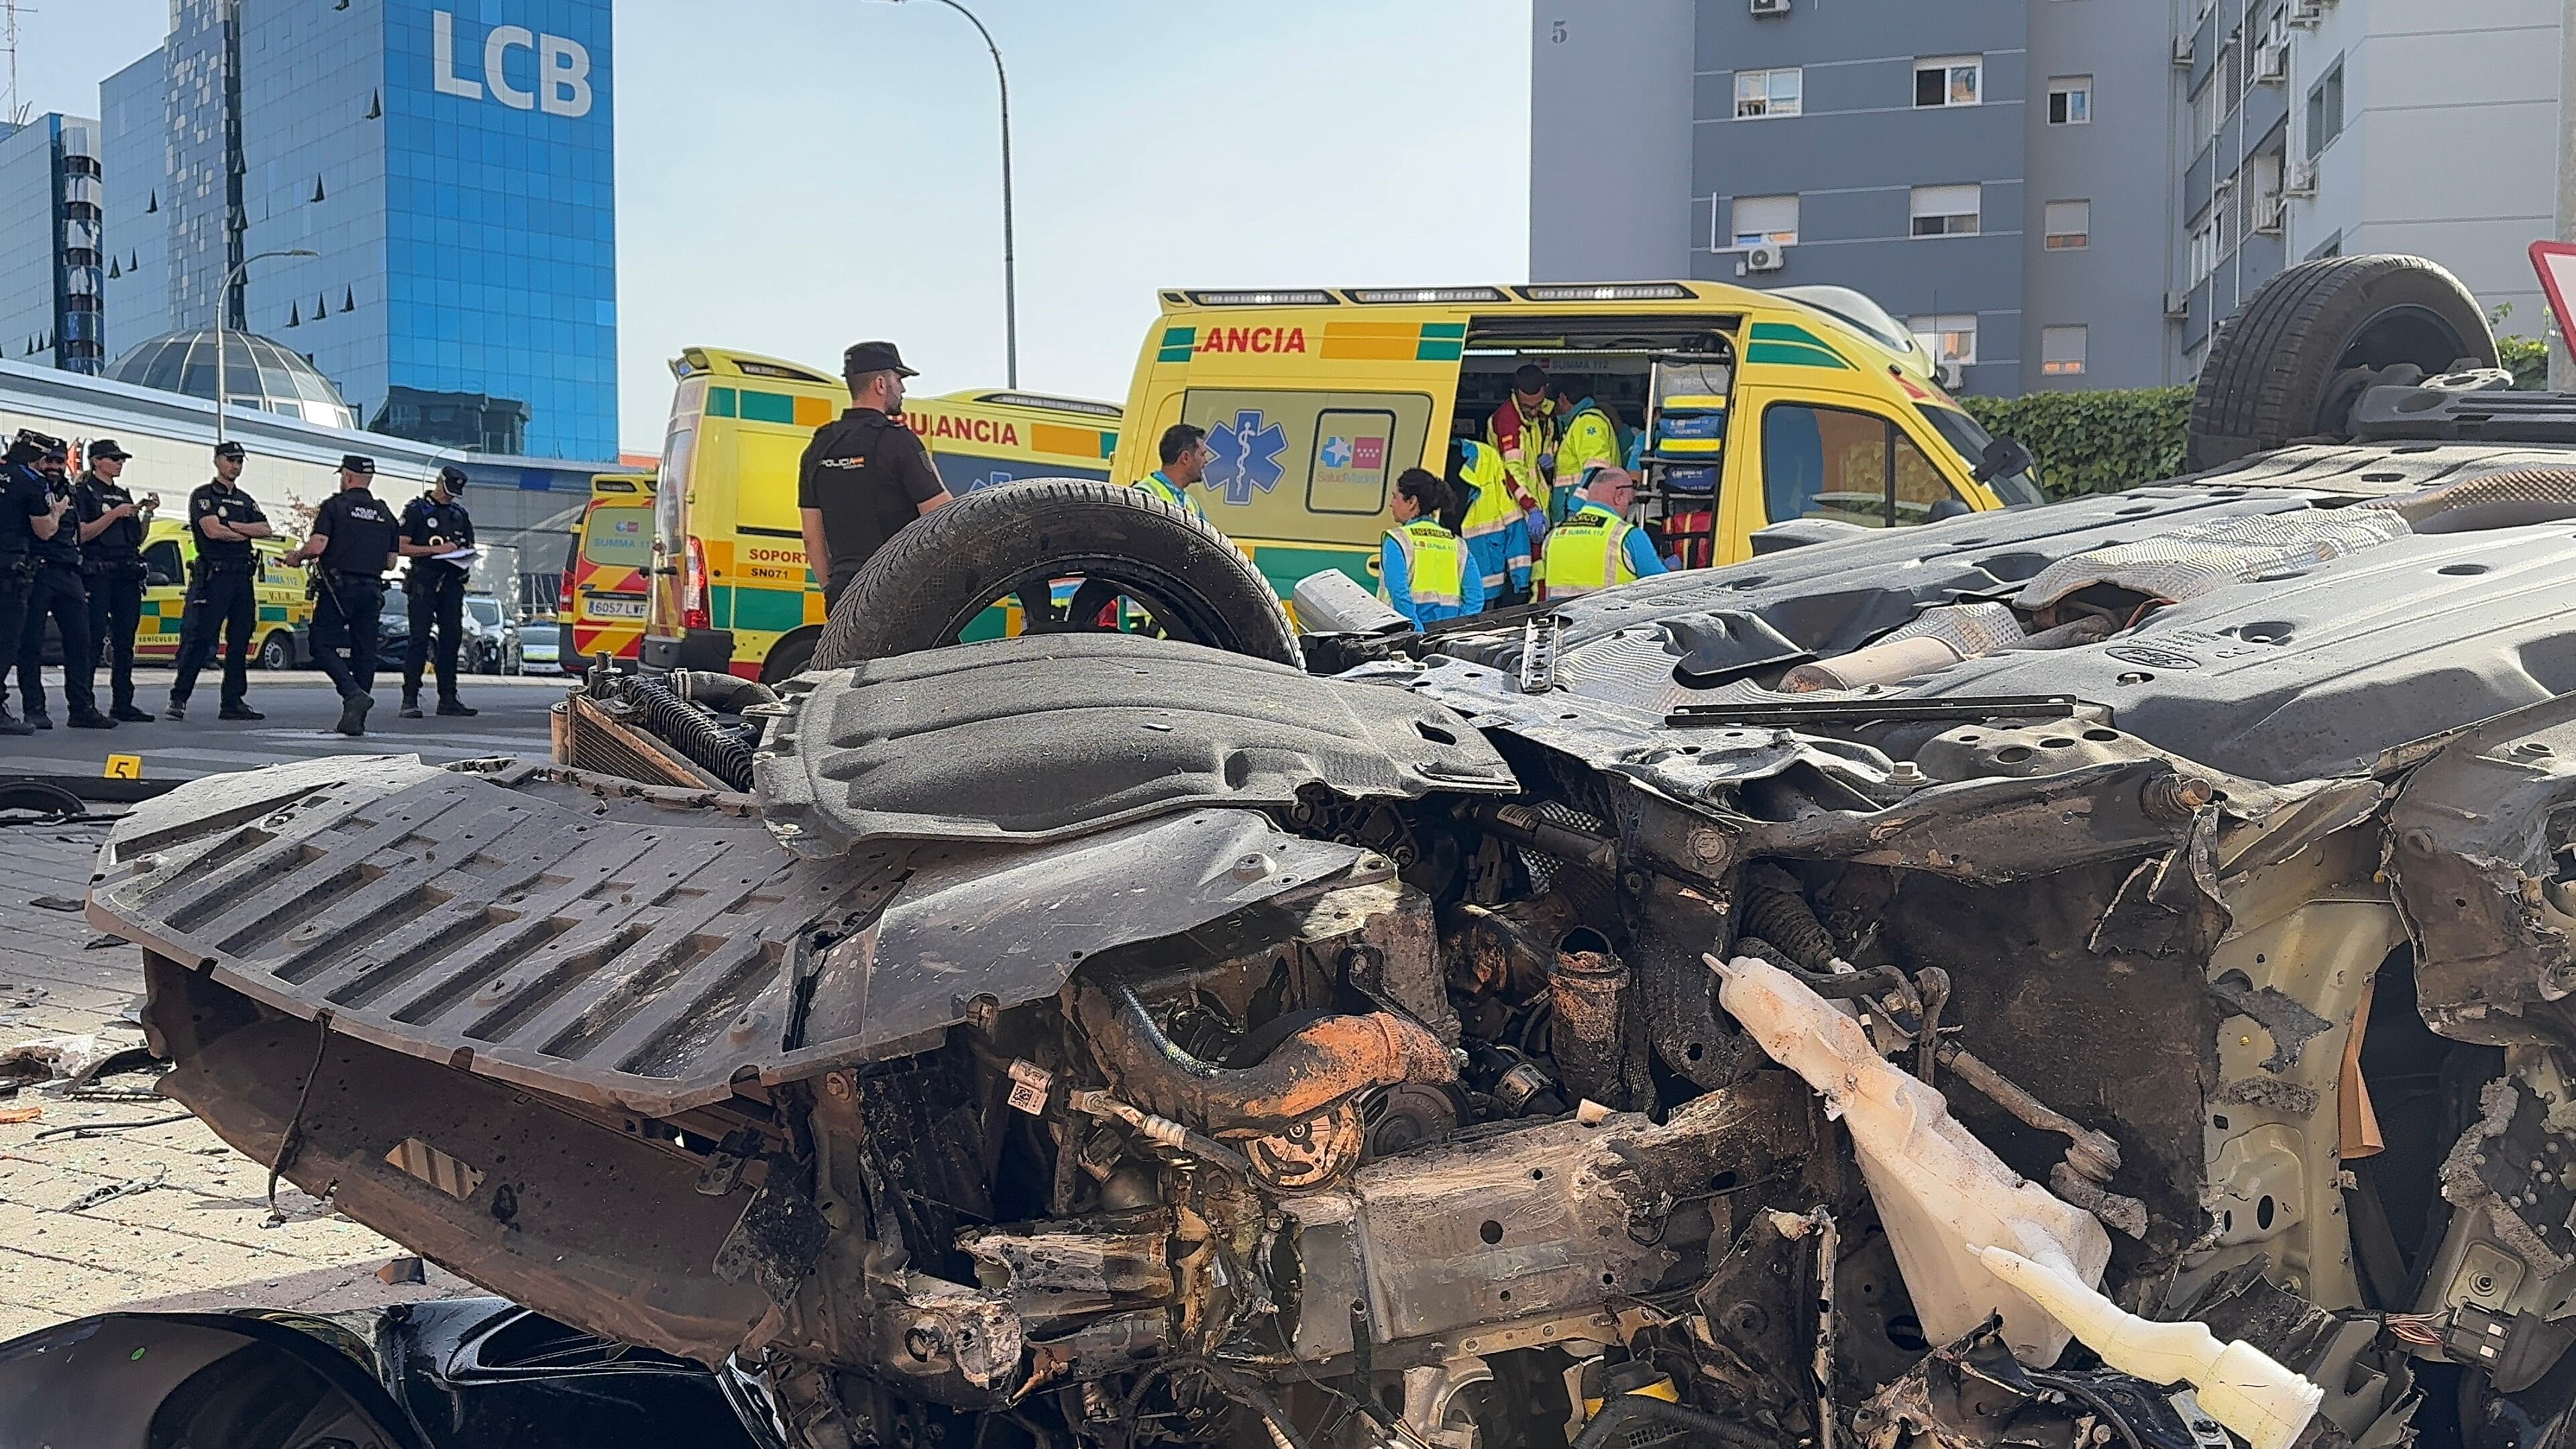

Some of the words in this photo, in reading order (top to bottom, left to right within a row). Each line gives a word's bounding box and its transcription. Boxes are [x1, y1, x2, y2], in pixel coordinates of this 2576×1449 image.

[1552, 19, 1568, 44] 5
[433, 9, 592, 118] LCB
[1193, 327, 1307, 353] ANCIA
[594, 538, 635, 548] SUMMA
[641, 539, 649, 548] 11
[749, 548, 808, 564] SOPORT
[751, 567, 788, 578] SN071
[596, 601, 623, 614] 6057
[114, 761, 129, 779] 5
